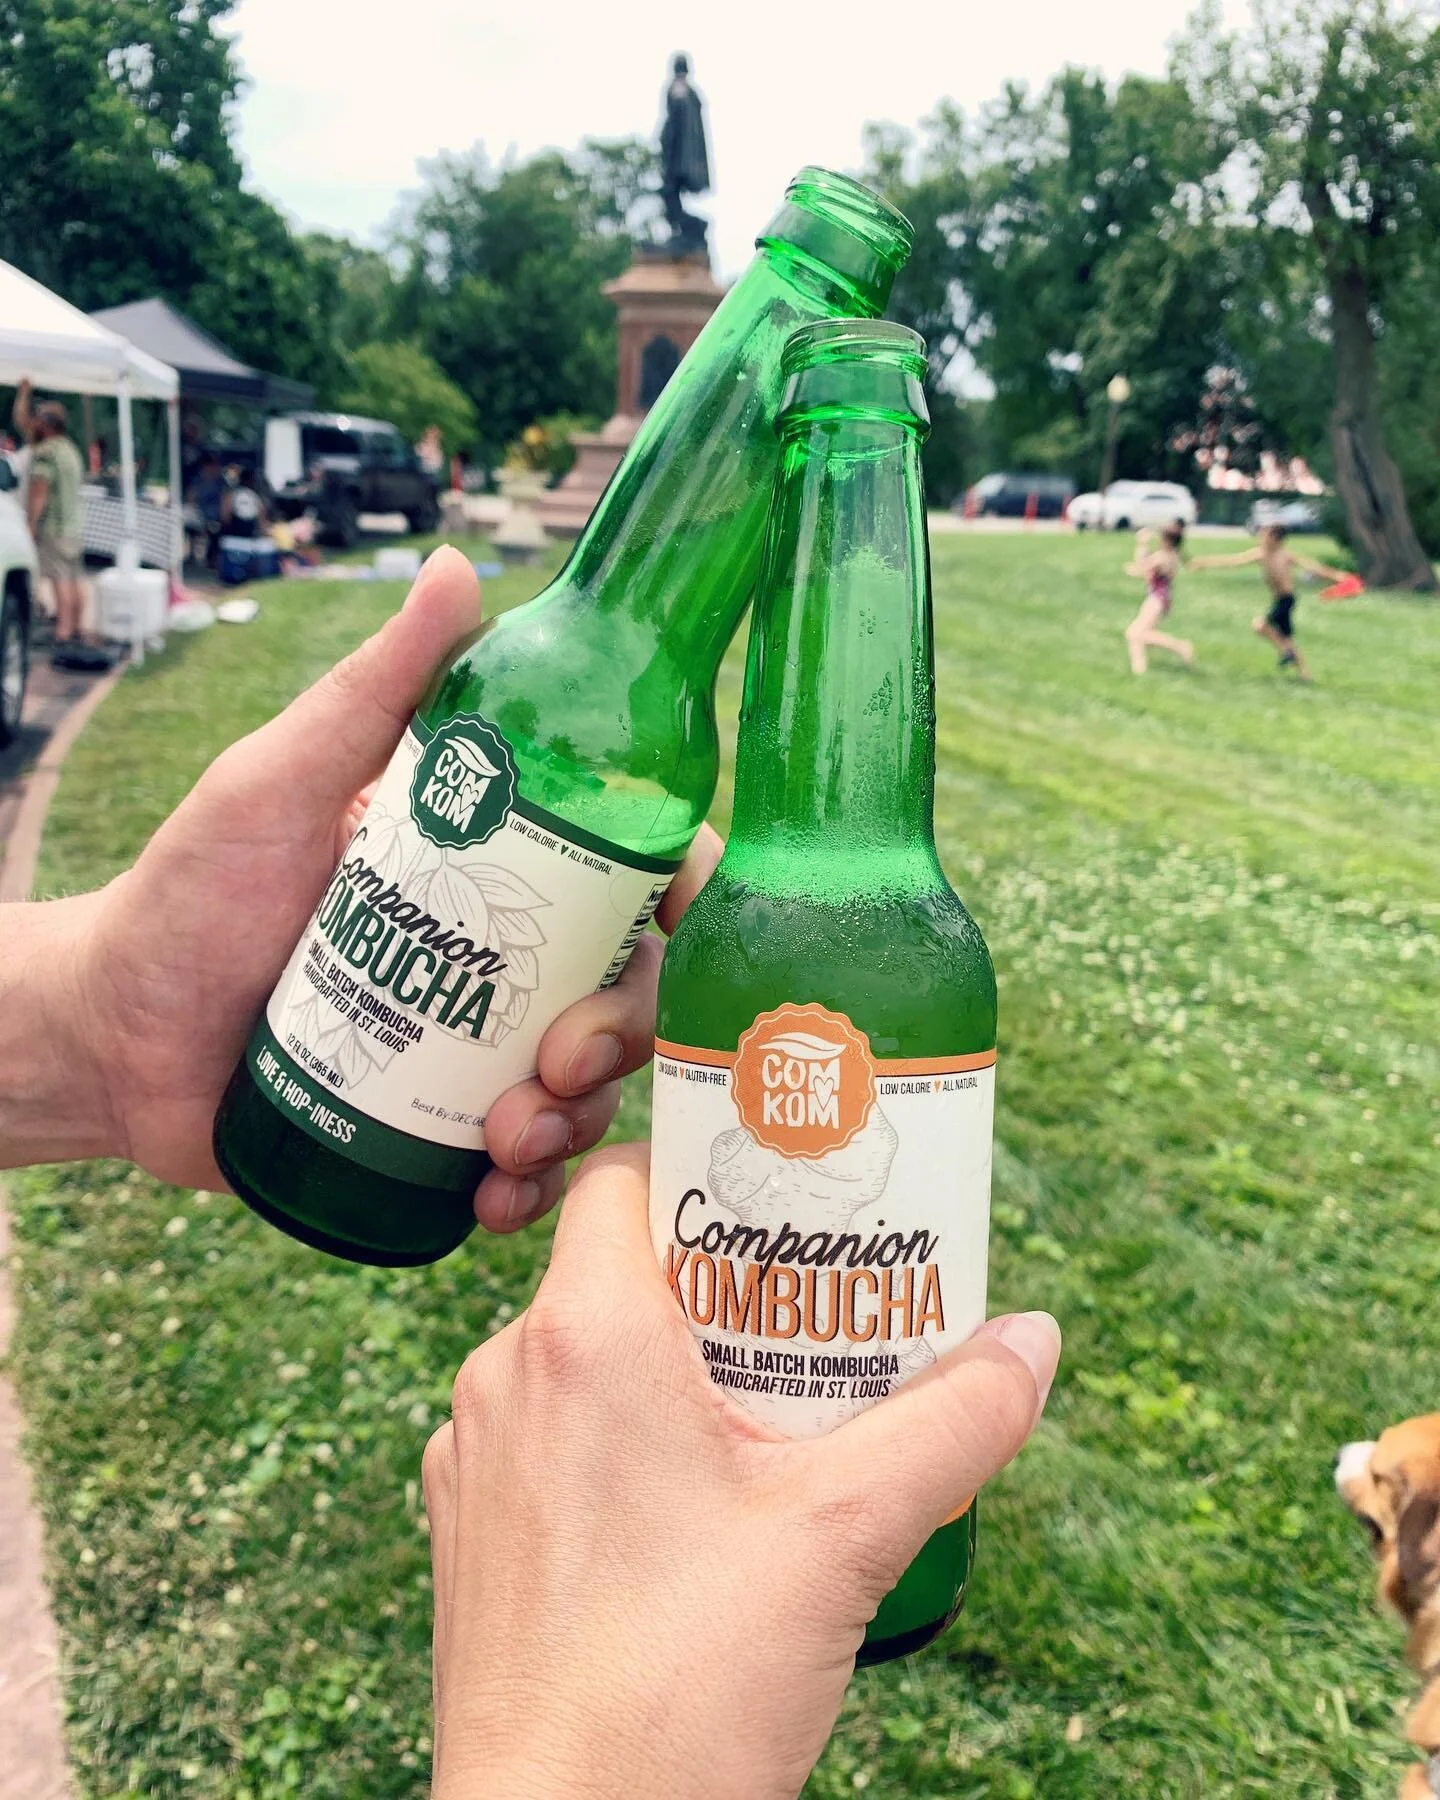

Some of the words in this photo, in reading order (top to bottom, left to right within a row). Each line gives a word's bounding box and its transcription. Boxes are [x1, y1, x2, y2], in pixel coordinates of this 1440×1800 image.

[434, 748, 492, 804] COM
[420, 776, 476, 833] KOM
[509, 818, 529, 834] LOW
[526, 828, 559, 850] CALORIE
[567, 849, 582, 863] ALL
[581, 855, 612, 875] NATURAL
[341, 827, 508, 976] Companion
[302, 960, 350, 1013] HANDCRAFTED
[346, 1006, 362, 1023] IN
[358, 1015, 376, 1034] ST.
[373, 1026, 410, 1053] LOUIS
[308, 938, 330, 973] SMALL
[326, 963, 359, 999] BATCH
[355, 988, 424, 1043] KOMBUCHA
[286, 1032, 296, 1047] 12
[292, 1040, 302, 1055] FL
[300, 1047, 312, 1063] OZ
[309, 1056, 329, 1077] (355
[326, 1070, 344, 1088] ML)
[685, 1068, 727, 1086] GLUTEN-FREE
[761, 1053, 840, 1092] COM
[256, 1045, 280, 1083] LOVE
[273, 1071, 287, 1092] &
[281, 1078, 357, 1143] HOP-INESS
[880, 1083, 899, 1095] LOW
[900, 1082, 931, 1095] CALORIE
[942, 1079, 954, 1092] ALL
[955, 1076, 978, 1091] NATURAL
[410, 1097, 435, 1114] Best
[763, 1091, 840, 1130] KOM
[674, 1188, 939, 1284] Companion
[667, 1243, 946, 1343] KOMBUCHA
[702, 1339, 749, 1369] SMALL
[753, 1349, 805, 1376] BATCH
[809, 1354, 899, 1378] KOMBUCHA
[710, 1366, 806, 1397] HANDCRAFTED
[808, 1380, 825, 1399] IN
[826, 1381, 846, 1399] ST.
[850, 1378, 892, 1399] LOUIS
